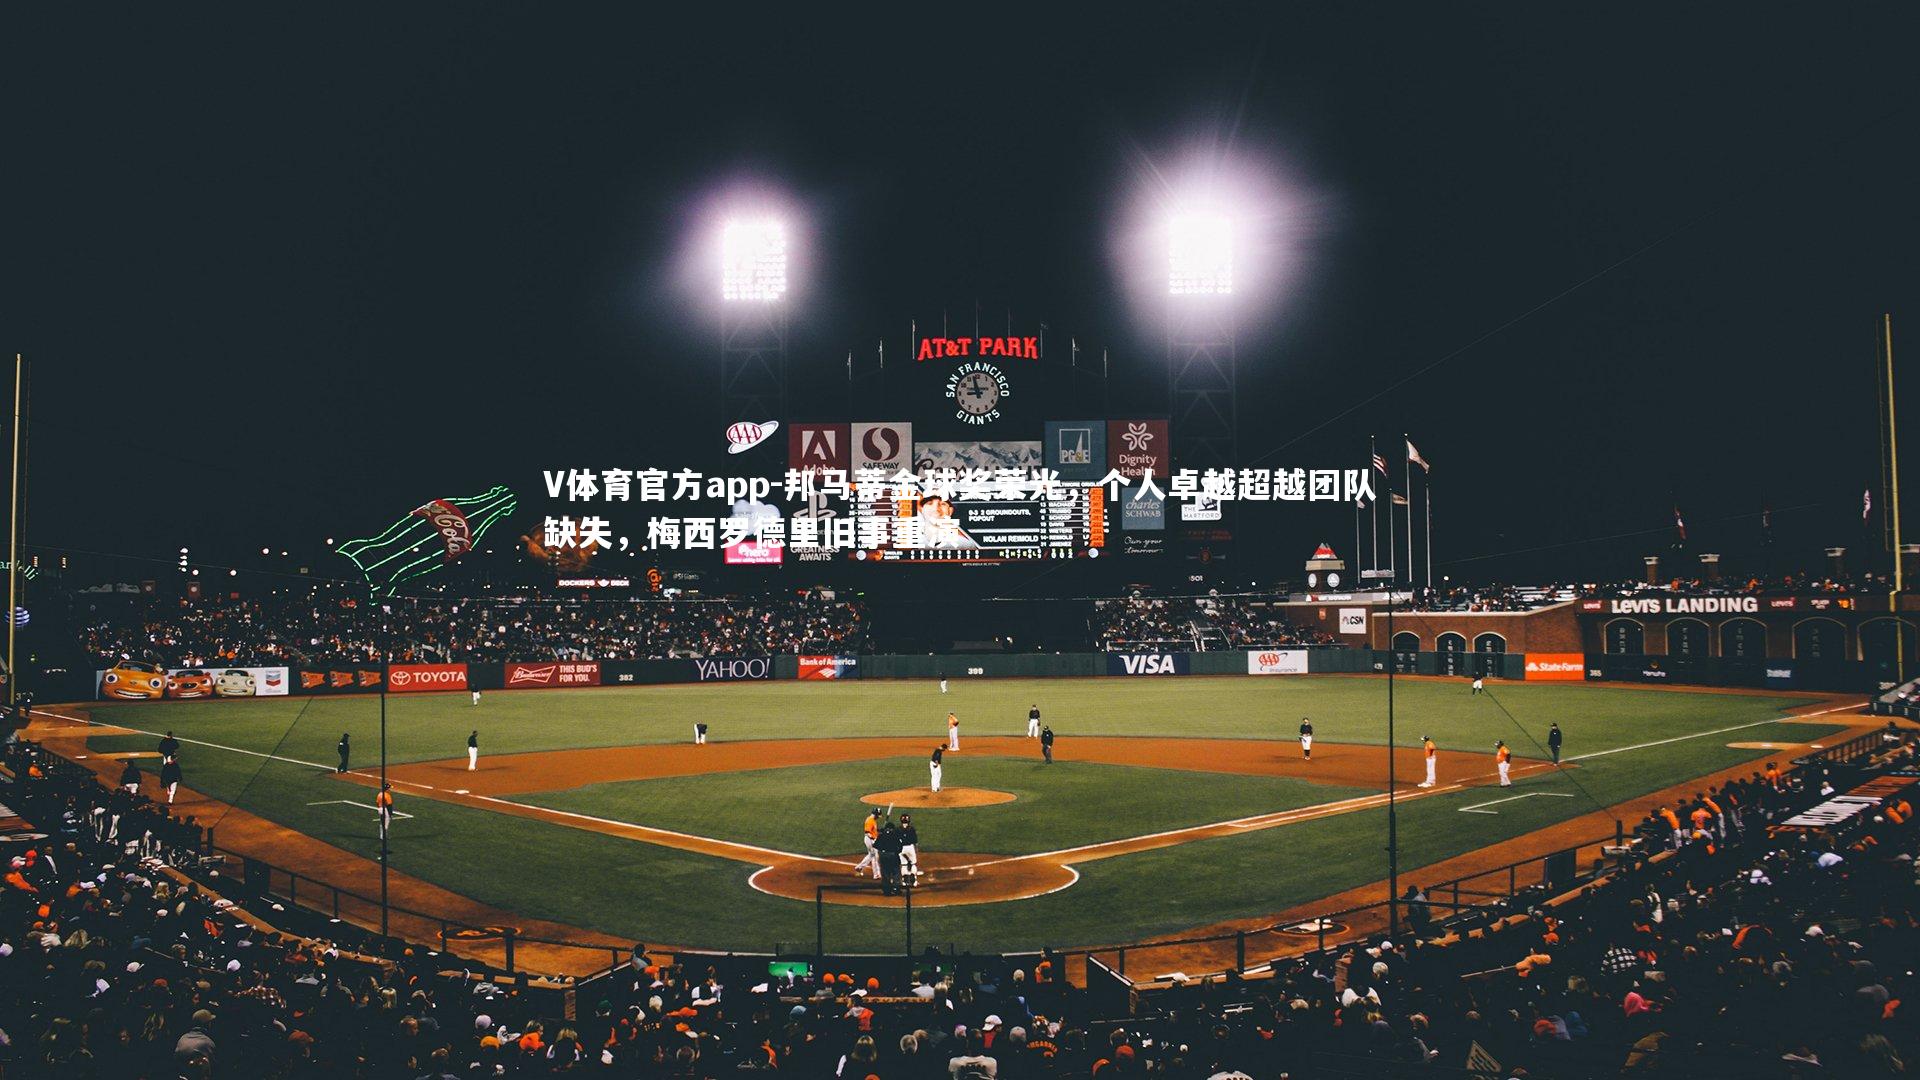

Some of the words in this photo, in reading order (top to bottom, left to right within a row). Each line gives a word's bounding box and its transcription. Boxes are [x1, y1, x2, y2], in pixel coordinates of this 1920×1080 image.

[918, 338, 972, 360] AT&T
[979, 336, 1038, 360] PARK
[946, 374, 960, 398] SAN
[958, 362, 1010, 397] FRANCISCO
[956, 409, 1000, 424] GIANTS
[1062, 450, 1090, 462] PG&E
[1119, 454, 1156, 466] Dignity
[862, 462, 900, 470] SAFEWAY
[1121, 467, 1156, 476] Healh
[1126, 499, 1160, 510] charles
[1125, 510, 1161, 518] SCHWAB
[1124, 536, 1142, 544] Own
[790, 545, 840, 554] GREATNESS
[799, 553, 832, 562] AWAITS
[1666, 597, 1758, 613] LANDING
[1350, 616, 1364, 625] CSN
[826, 658, 856, 666] America
[1119, 654, 1176, 674] VISA
[559, 665, 575, 674] THIS
[576, 664, 598, 673] BUD'S
[695, 658, 770, 680] YAHOO!
[412, 671, 467, 682] TOYOTA
[559, 674, 573, 682] FOR
[574, 674, 590, 682] YOU.
